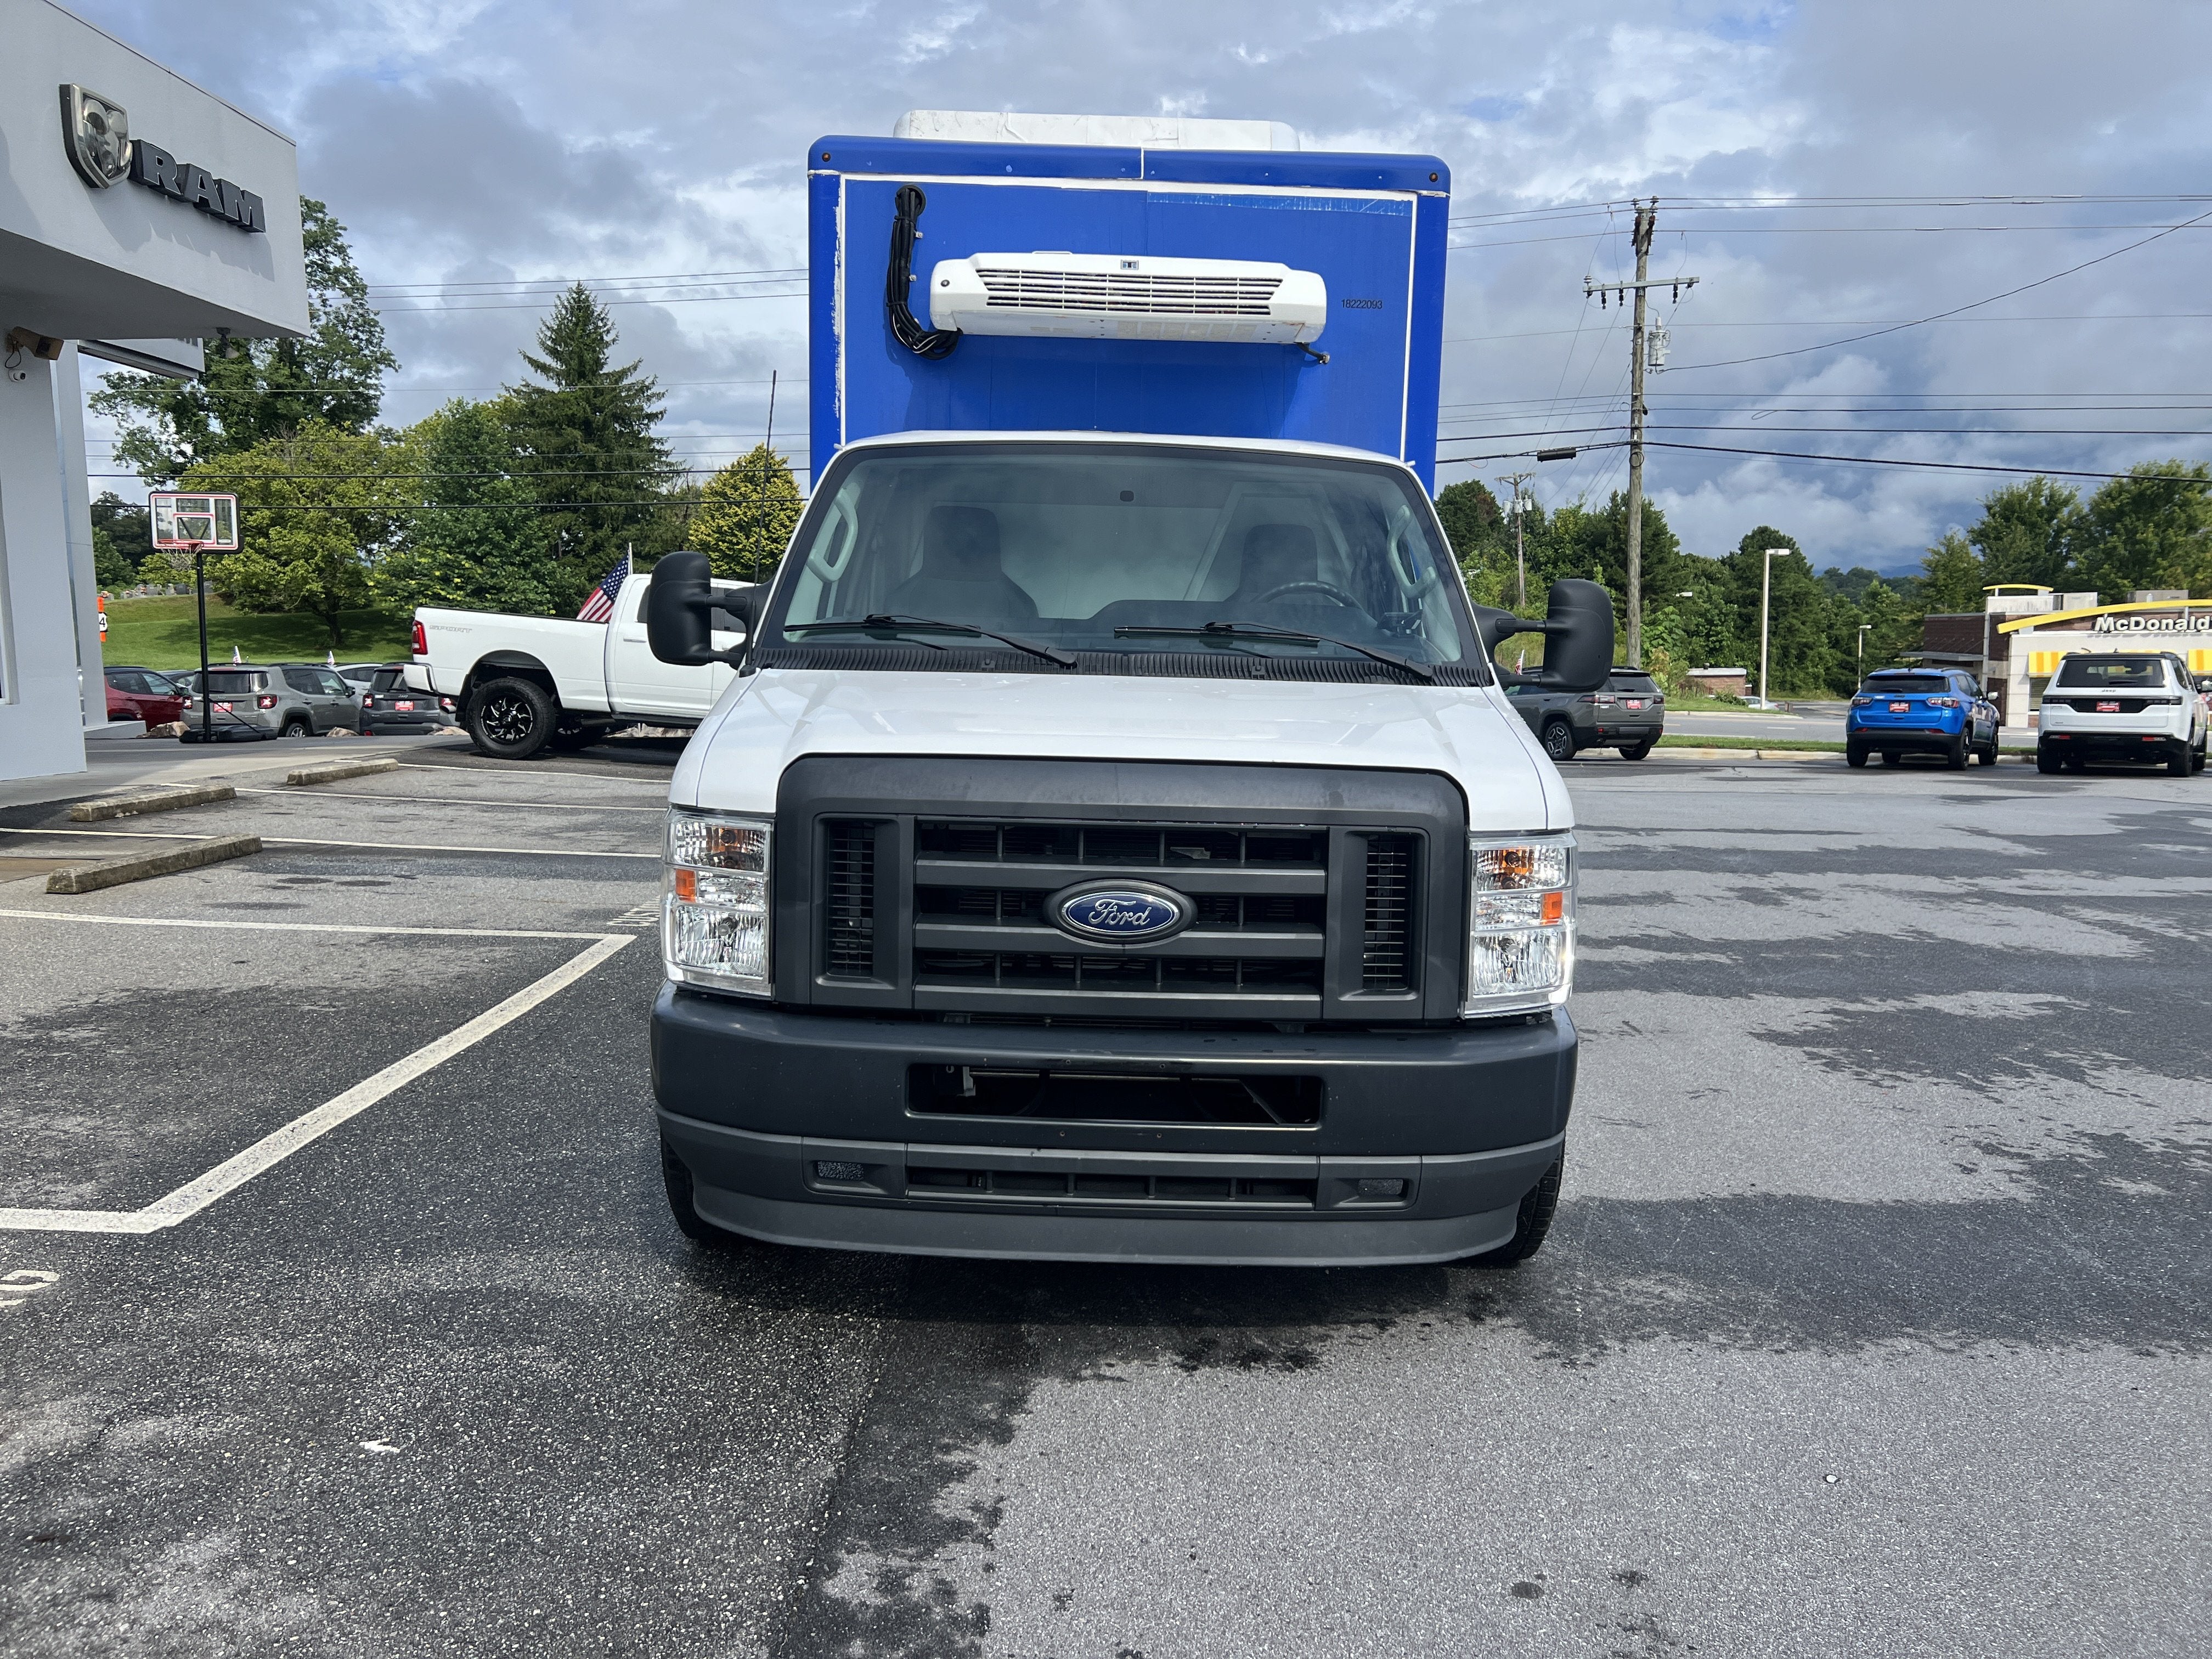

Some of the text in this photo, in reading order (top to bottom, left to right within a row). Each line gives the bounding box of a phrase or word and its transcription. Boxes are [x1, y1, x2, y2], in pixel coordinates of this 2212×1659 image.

[128, 139, 266, 233] RAM
[1341, 299, 1383, 309] 18222093
[99, 617, 105, 627] 4
[2094, 616, 2212, 631] McDonald
[1088, 899, 1152, 926] Ford
